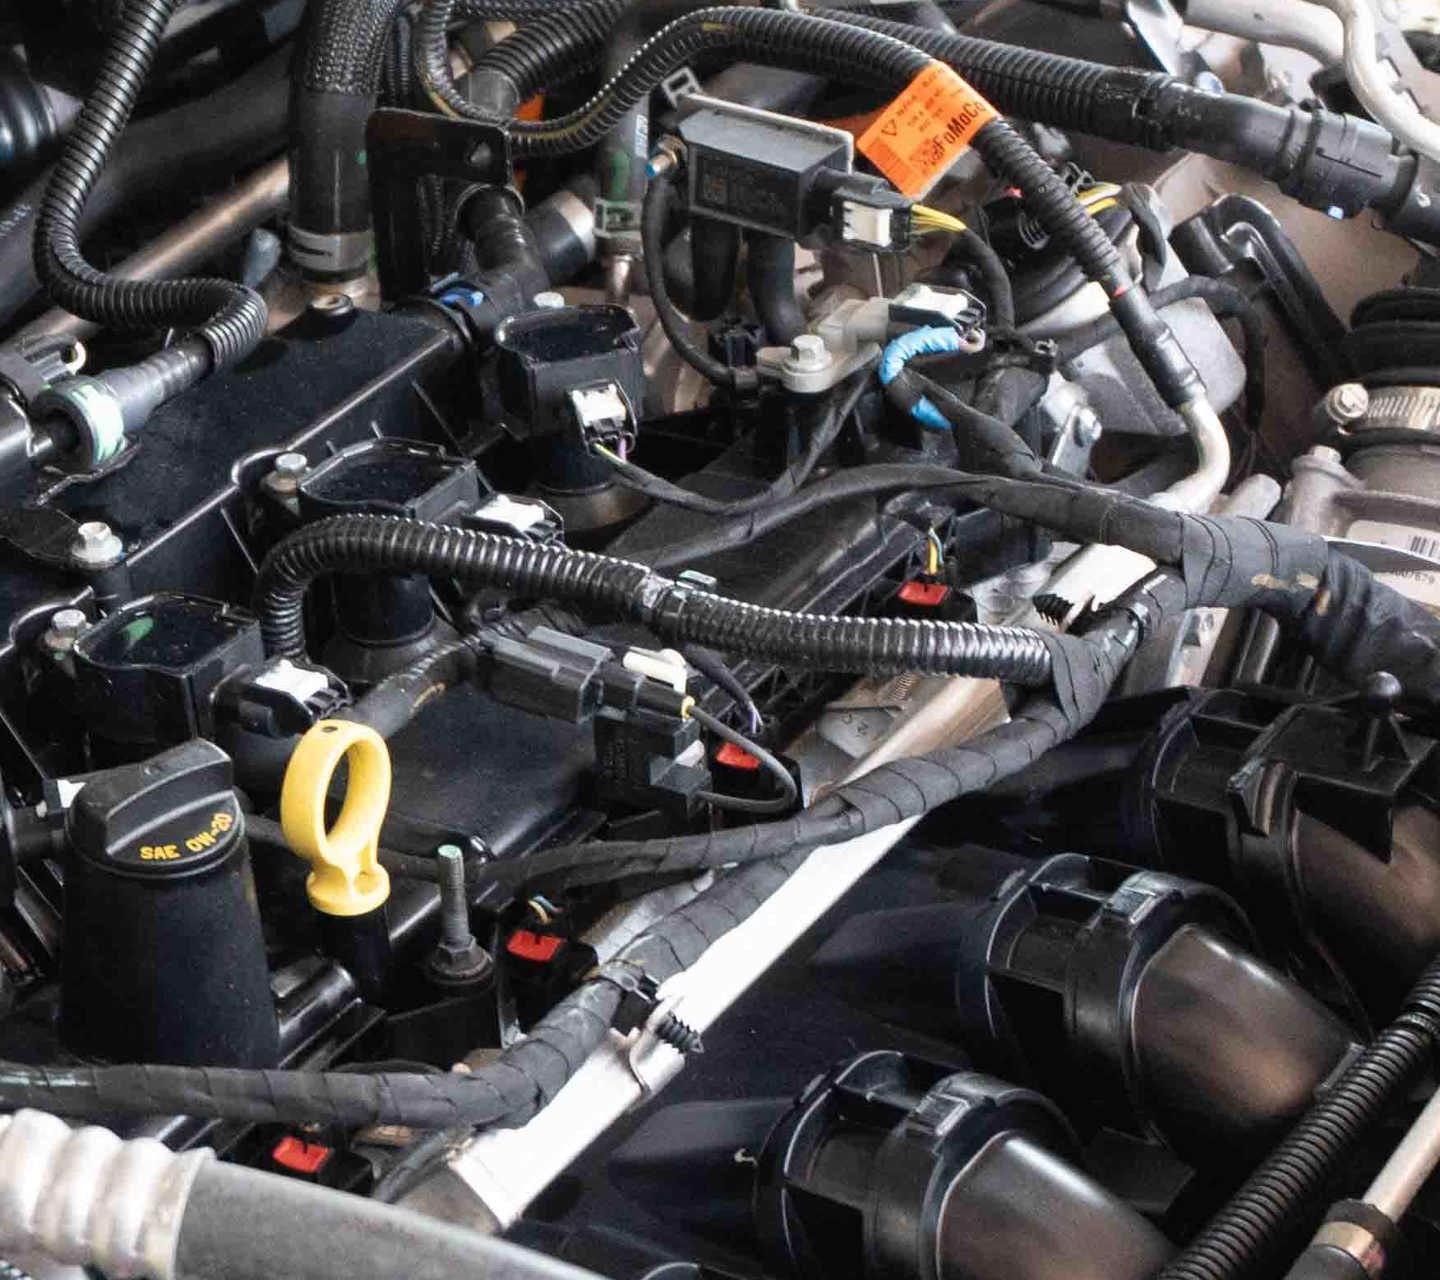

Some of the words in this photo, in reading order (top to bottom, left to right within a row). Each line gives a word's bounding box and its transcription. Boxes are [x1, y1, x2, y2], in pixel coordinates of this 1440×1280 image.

[933, 101, 986, 154] FoMoCo
[140, 845, 180, 860] SAE
[185, 812, 233, 852] 0W-20
